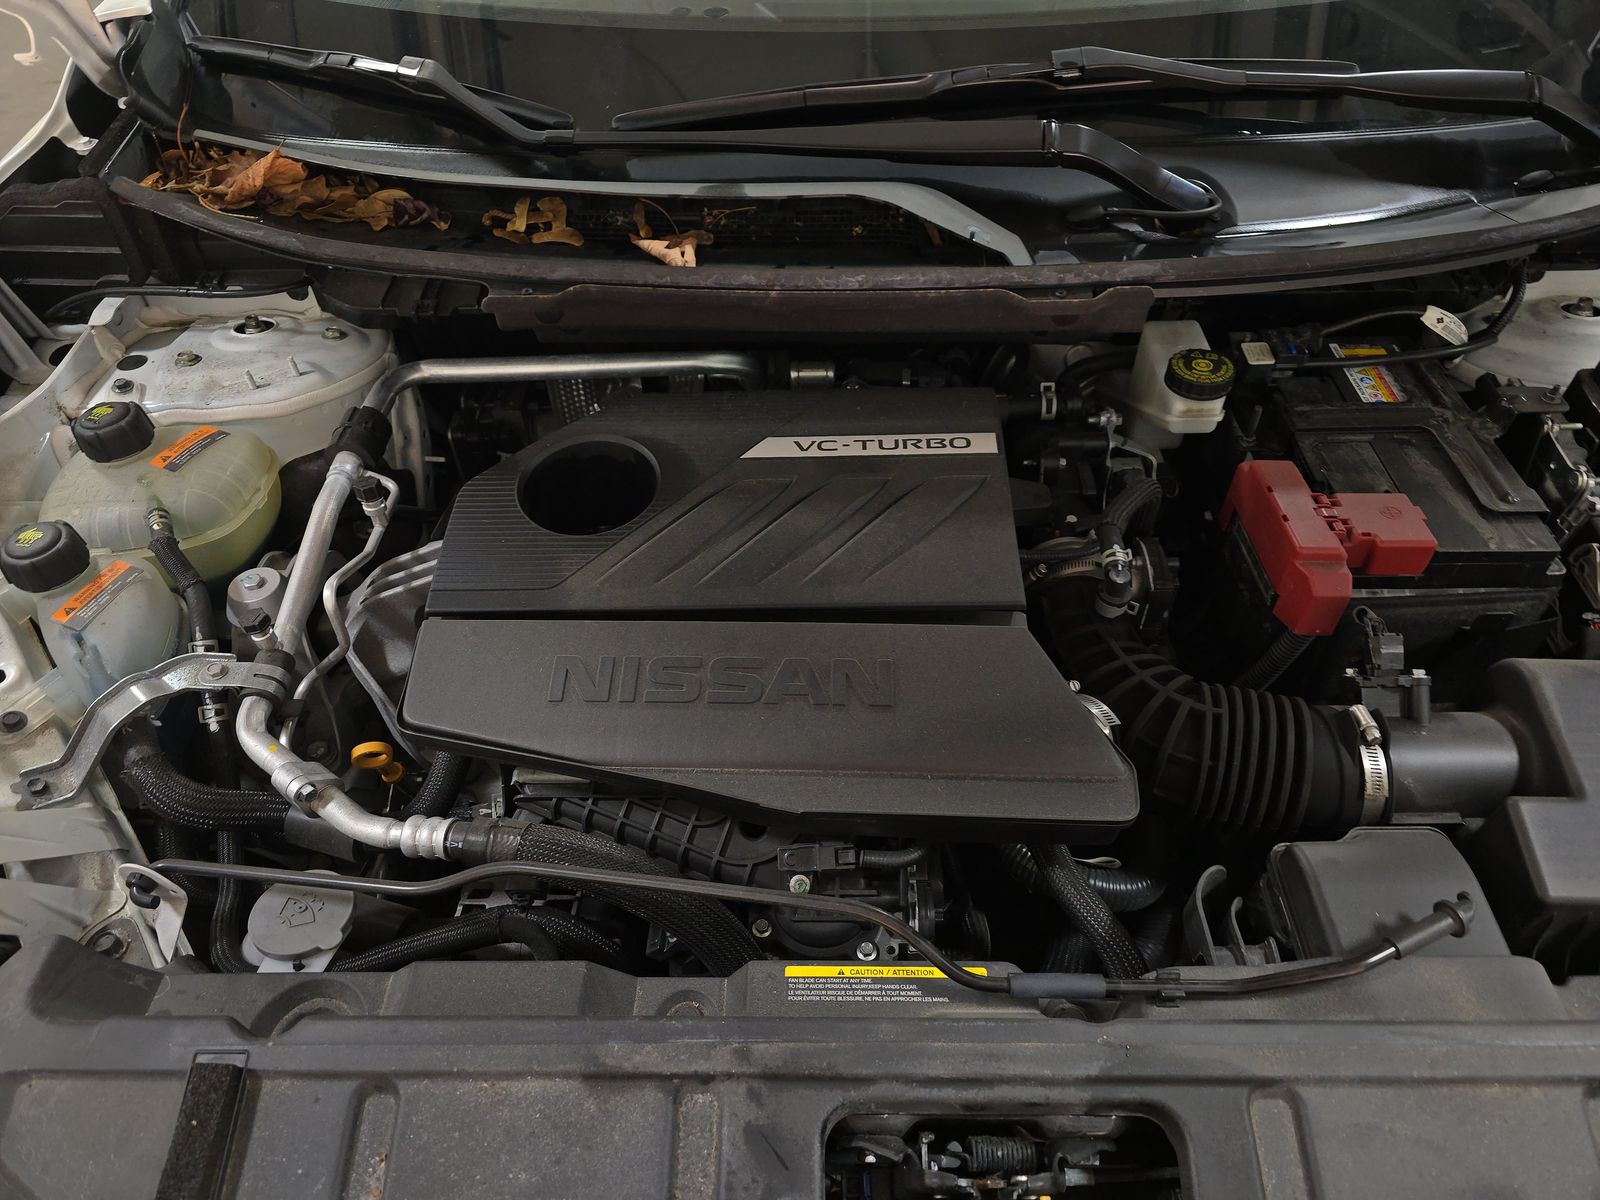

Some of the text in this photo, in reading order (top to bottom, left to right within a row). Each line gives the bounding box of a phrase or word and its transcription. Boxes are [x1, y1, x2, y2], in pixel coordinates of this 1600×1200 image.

[792, 436, 972, 452] VC-TURBO
[547, 655, 896, 708] NISSAN
[849, 968, 884, 976] CAUTION
